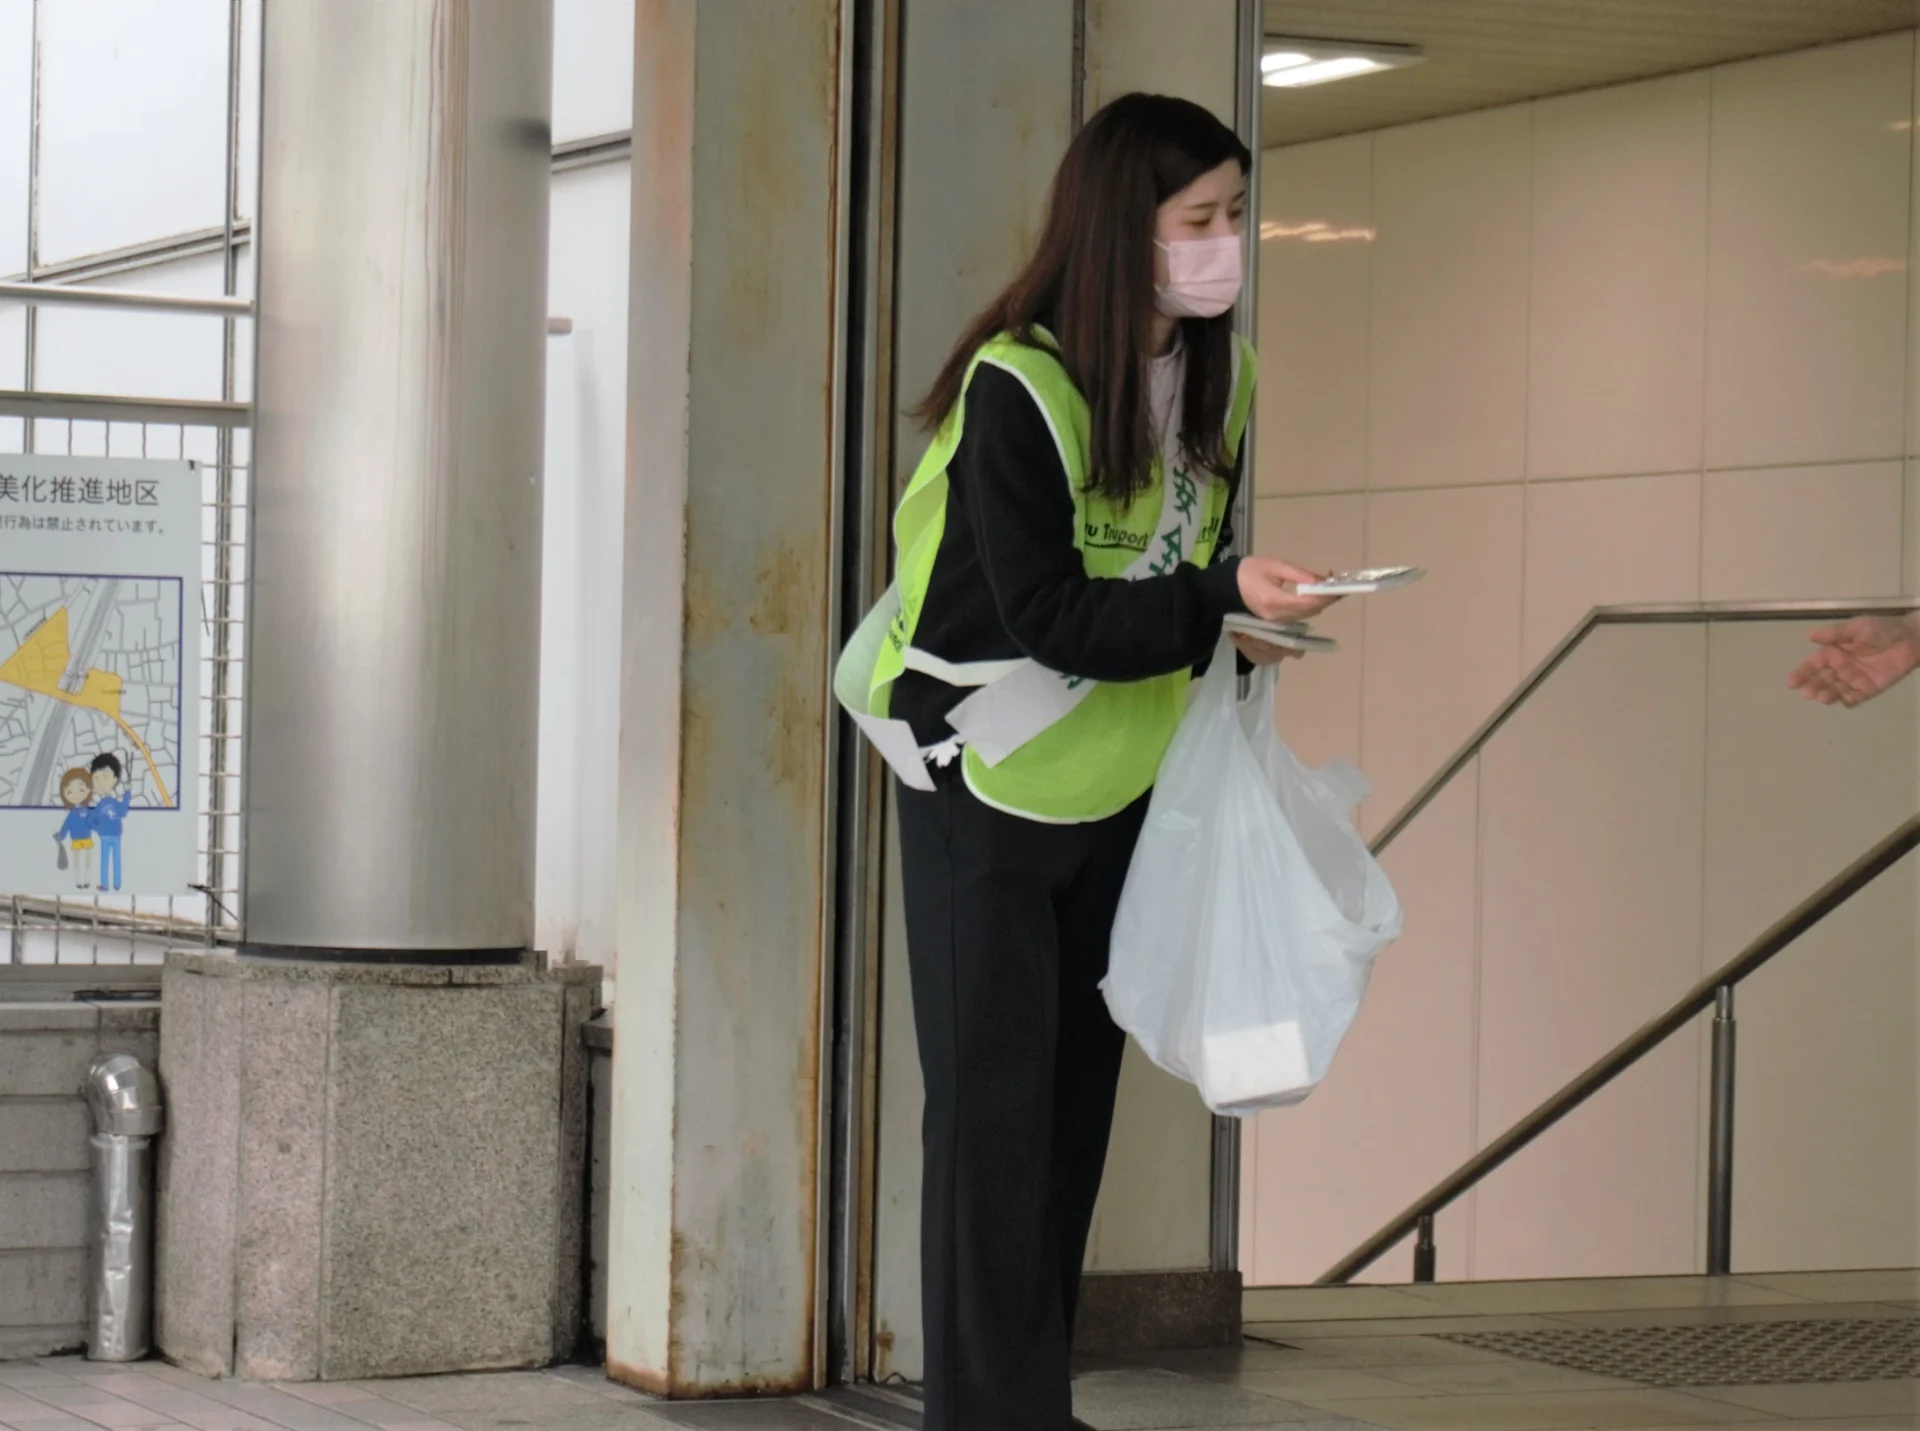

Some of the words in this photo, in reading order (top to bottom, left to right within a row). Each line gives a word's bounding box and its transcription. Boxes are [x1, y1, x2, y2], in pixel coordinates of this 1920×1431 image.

[0, 474, 159, 506] 美化推進地区
[0, 515, 164, 534] 行為は禁止されています。
